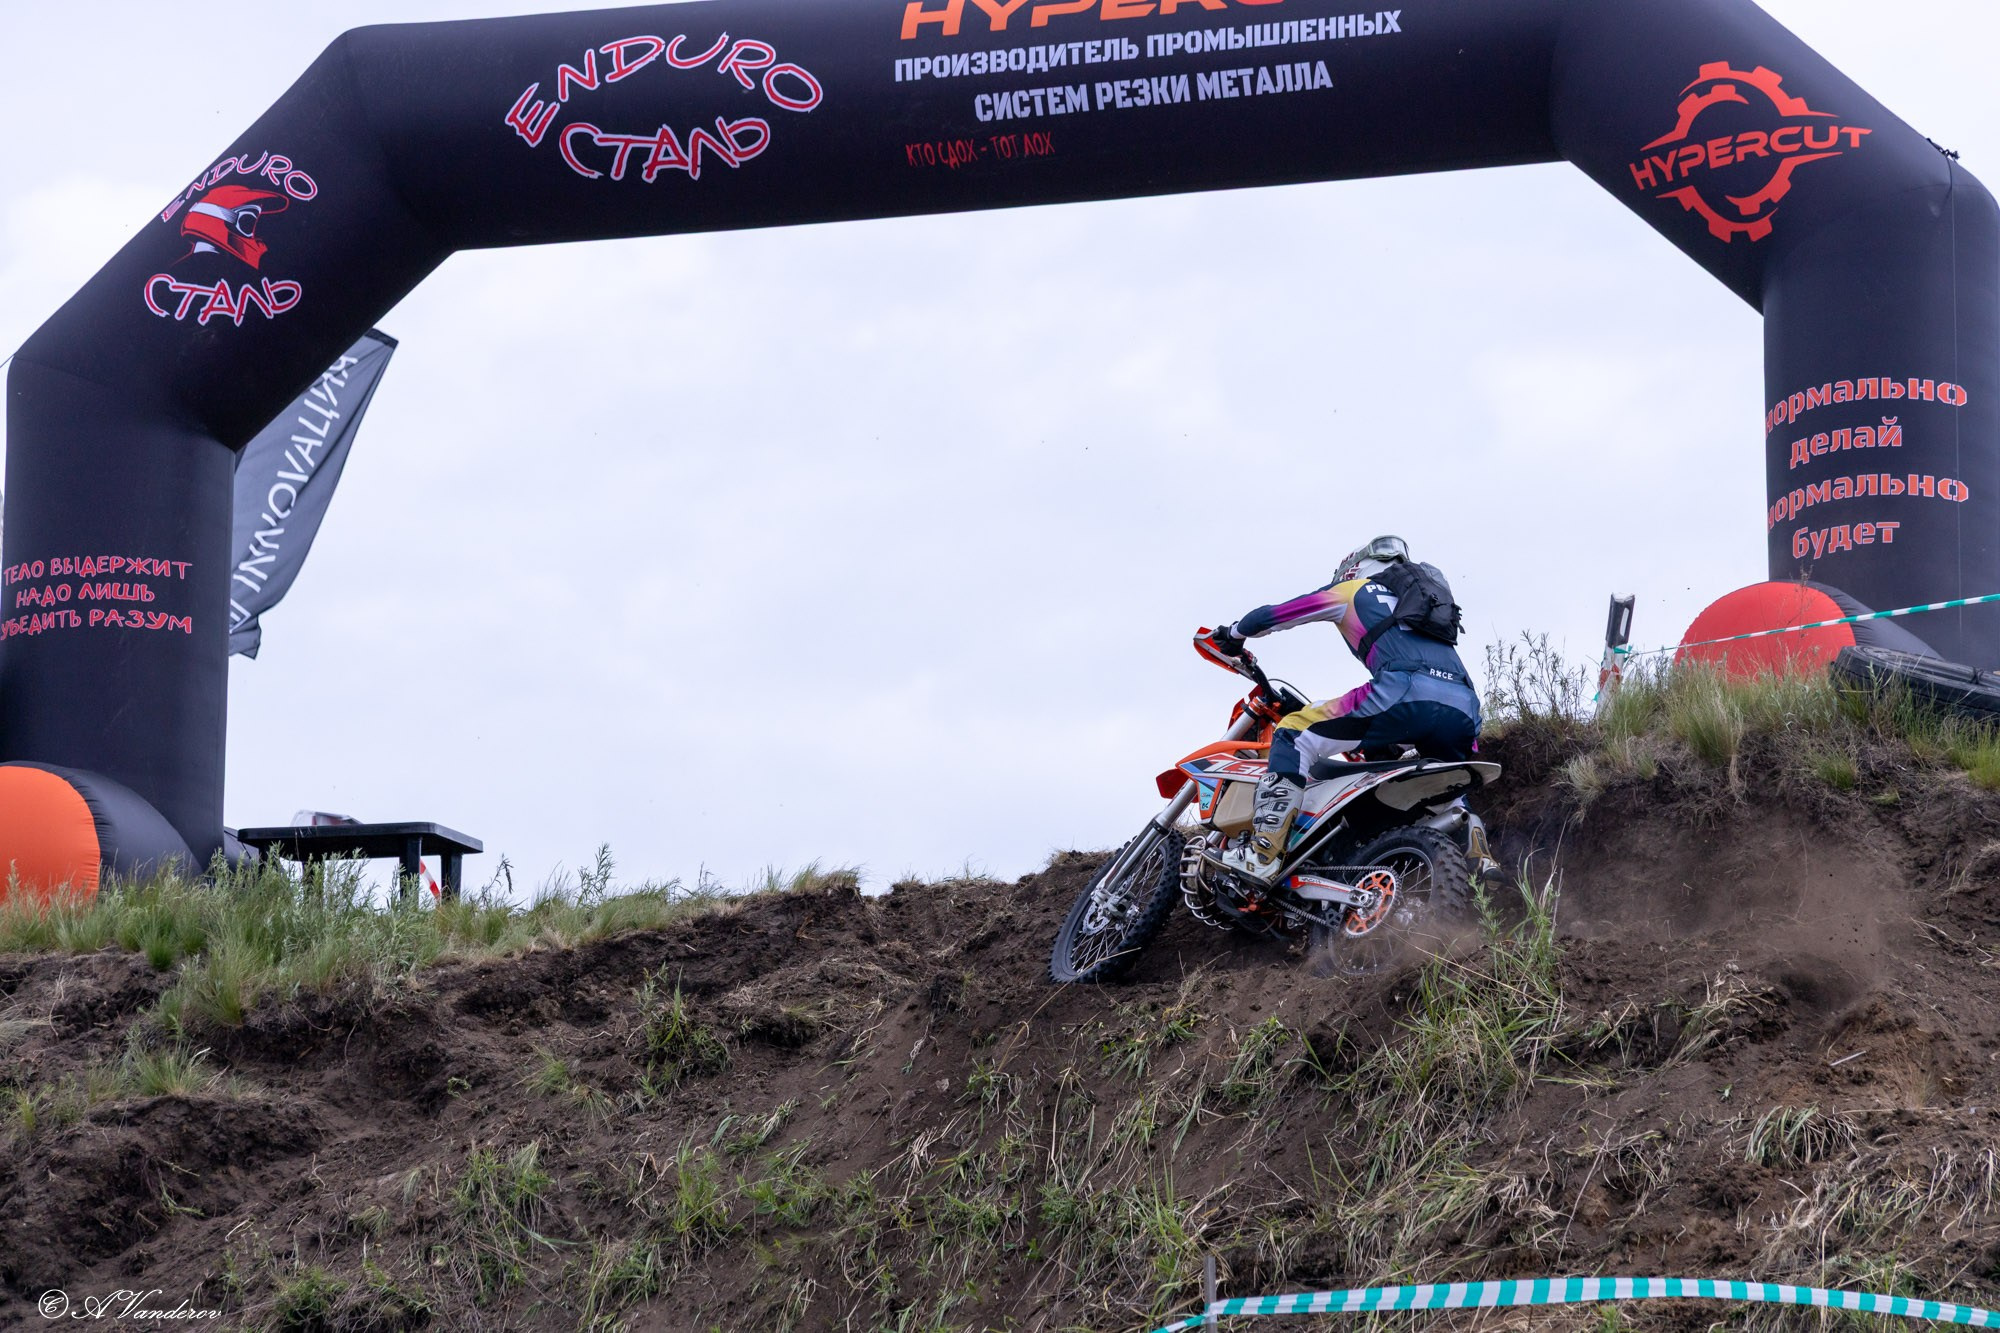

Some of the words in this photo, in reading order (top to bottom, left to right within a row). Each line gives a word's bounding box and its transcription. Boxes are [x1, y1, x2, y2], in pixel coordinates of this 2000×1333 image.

[895, 37, 1140, 82] ПРОИЗВОДИТЕЛЬ
[1146, 9, 1402, 58] ПРОМЫШЛЕННЫХ
[504, 31, 824, 148] ENDURO
[974, 83, 1090, 122] СИСТЕМ
[1095, 74, 1191, 111] РЕЗКИ
[1196, 60, 1334, 101] МЕТАЛЛА
[905, 139, 935, 168] КТО
[938, 138, 979, 170] СДОХ
[989, 134, 1018, 160] ТОТ
[1023, 131, 1056, 158] ЛОХ
[1628, 125, 1873, 191] HYPERCUT
[160, 150, 318, 223] ENDURO
[1764, 377, 1968, 440] нормально
[1789, 416, 1903, 470] делай
[1767, 473, 1970, 535] нормально
[3, 560, 45, 586] ТЕЛО
[50, 555, 193, 580] ВЫДЕРЖИТ
[1792, 521, 1901, 560] будет
[0, 609, 82, 641] УБЕДИТЬ
[89, 609, 192, 634] РАЗУМ
[16, 583, 72, 608] НАДО
[78, 582, 156, 602] ЛИШЬ
